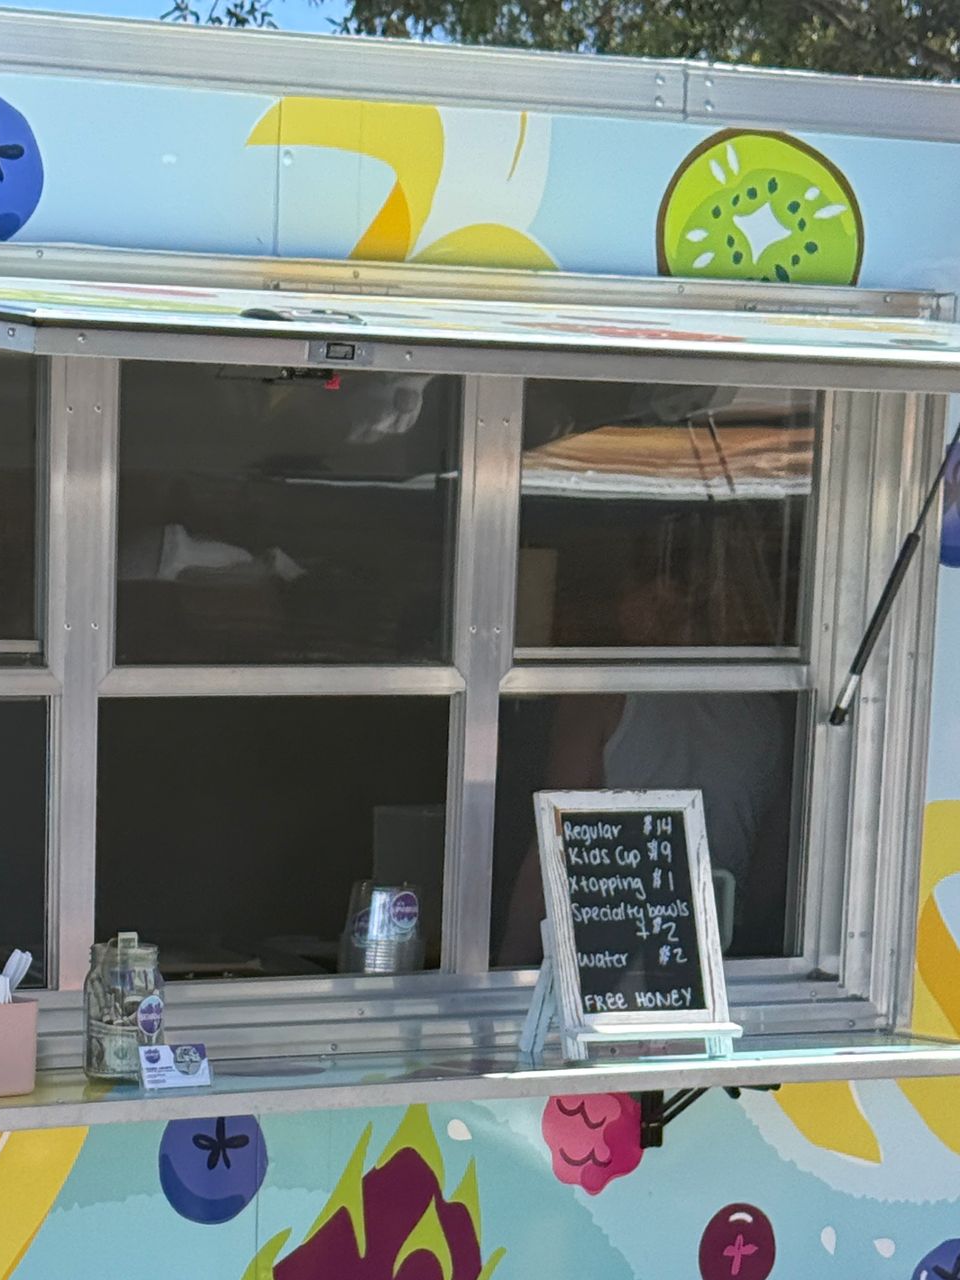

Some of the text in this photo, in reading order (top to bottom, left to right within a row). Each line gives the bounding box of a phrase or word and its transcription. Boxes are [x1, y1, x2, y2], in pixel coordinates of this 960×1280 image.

[563, 820, 622, 846] Regular
[568, 847, 610, 865] Kids
[615, 845, 641, 868] Cup
[571, 899, 690, 927] Specialty bowls
[635, 987, 693, 1007] HONEY
